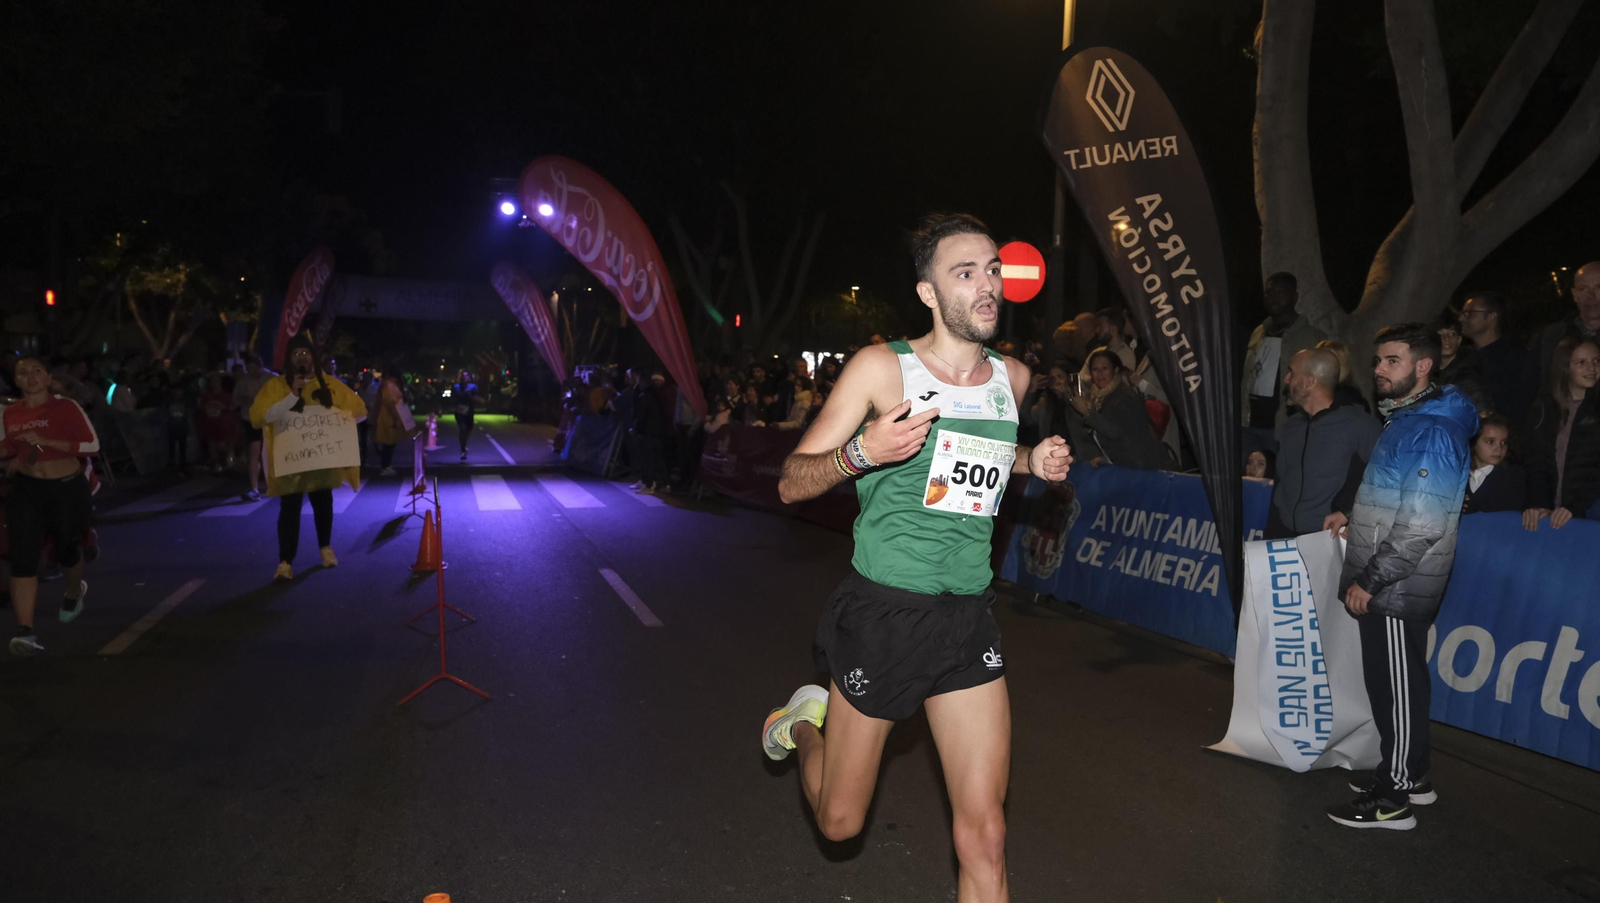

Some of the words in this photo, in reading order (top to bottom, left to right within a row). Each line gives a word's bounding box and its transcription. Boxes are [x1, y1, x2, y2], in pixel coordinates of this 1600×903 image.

[301, 429, 329, 442] FOR
[970, 438, 986, 449] SAN
[956, 445, 982, 458] CIUDAD
[982, 450, 992, 460] DE
[951, 460, 1000, 489] 500
[965, 489, 983, 499] MARIO
[1075, 537, 1112, 568] DE
[1109, 545, 1221, 597] ALMERÍA
[1277, 675, 1309, 728] SAN
